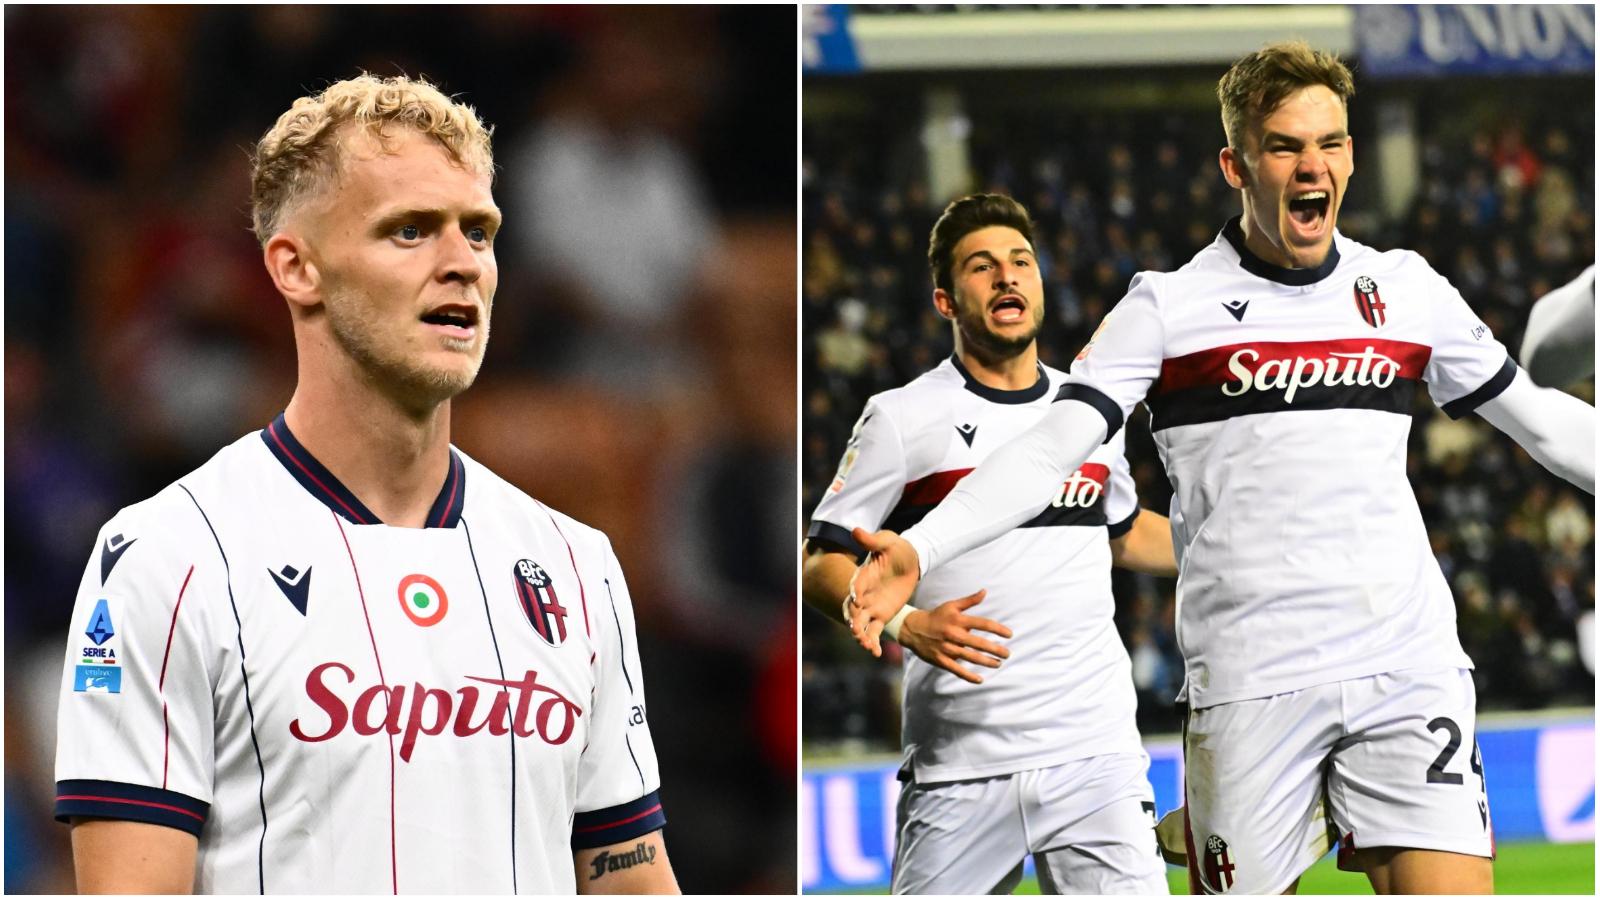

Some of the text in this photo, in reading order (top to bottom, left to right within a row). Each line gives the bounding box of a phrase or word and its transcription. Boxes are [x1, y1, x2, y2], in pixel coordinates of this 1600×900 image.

[1221, 346, 1401, 404] Saputo
[518, 560, 546, 580] BFC
[83, 647, 115, 658] SERIE A
[289, 662, 582, 763] Saputo
[589, 841, 656, 880] Family
